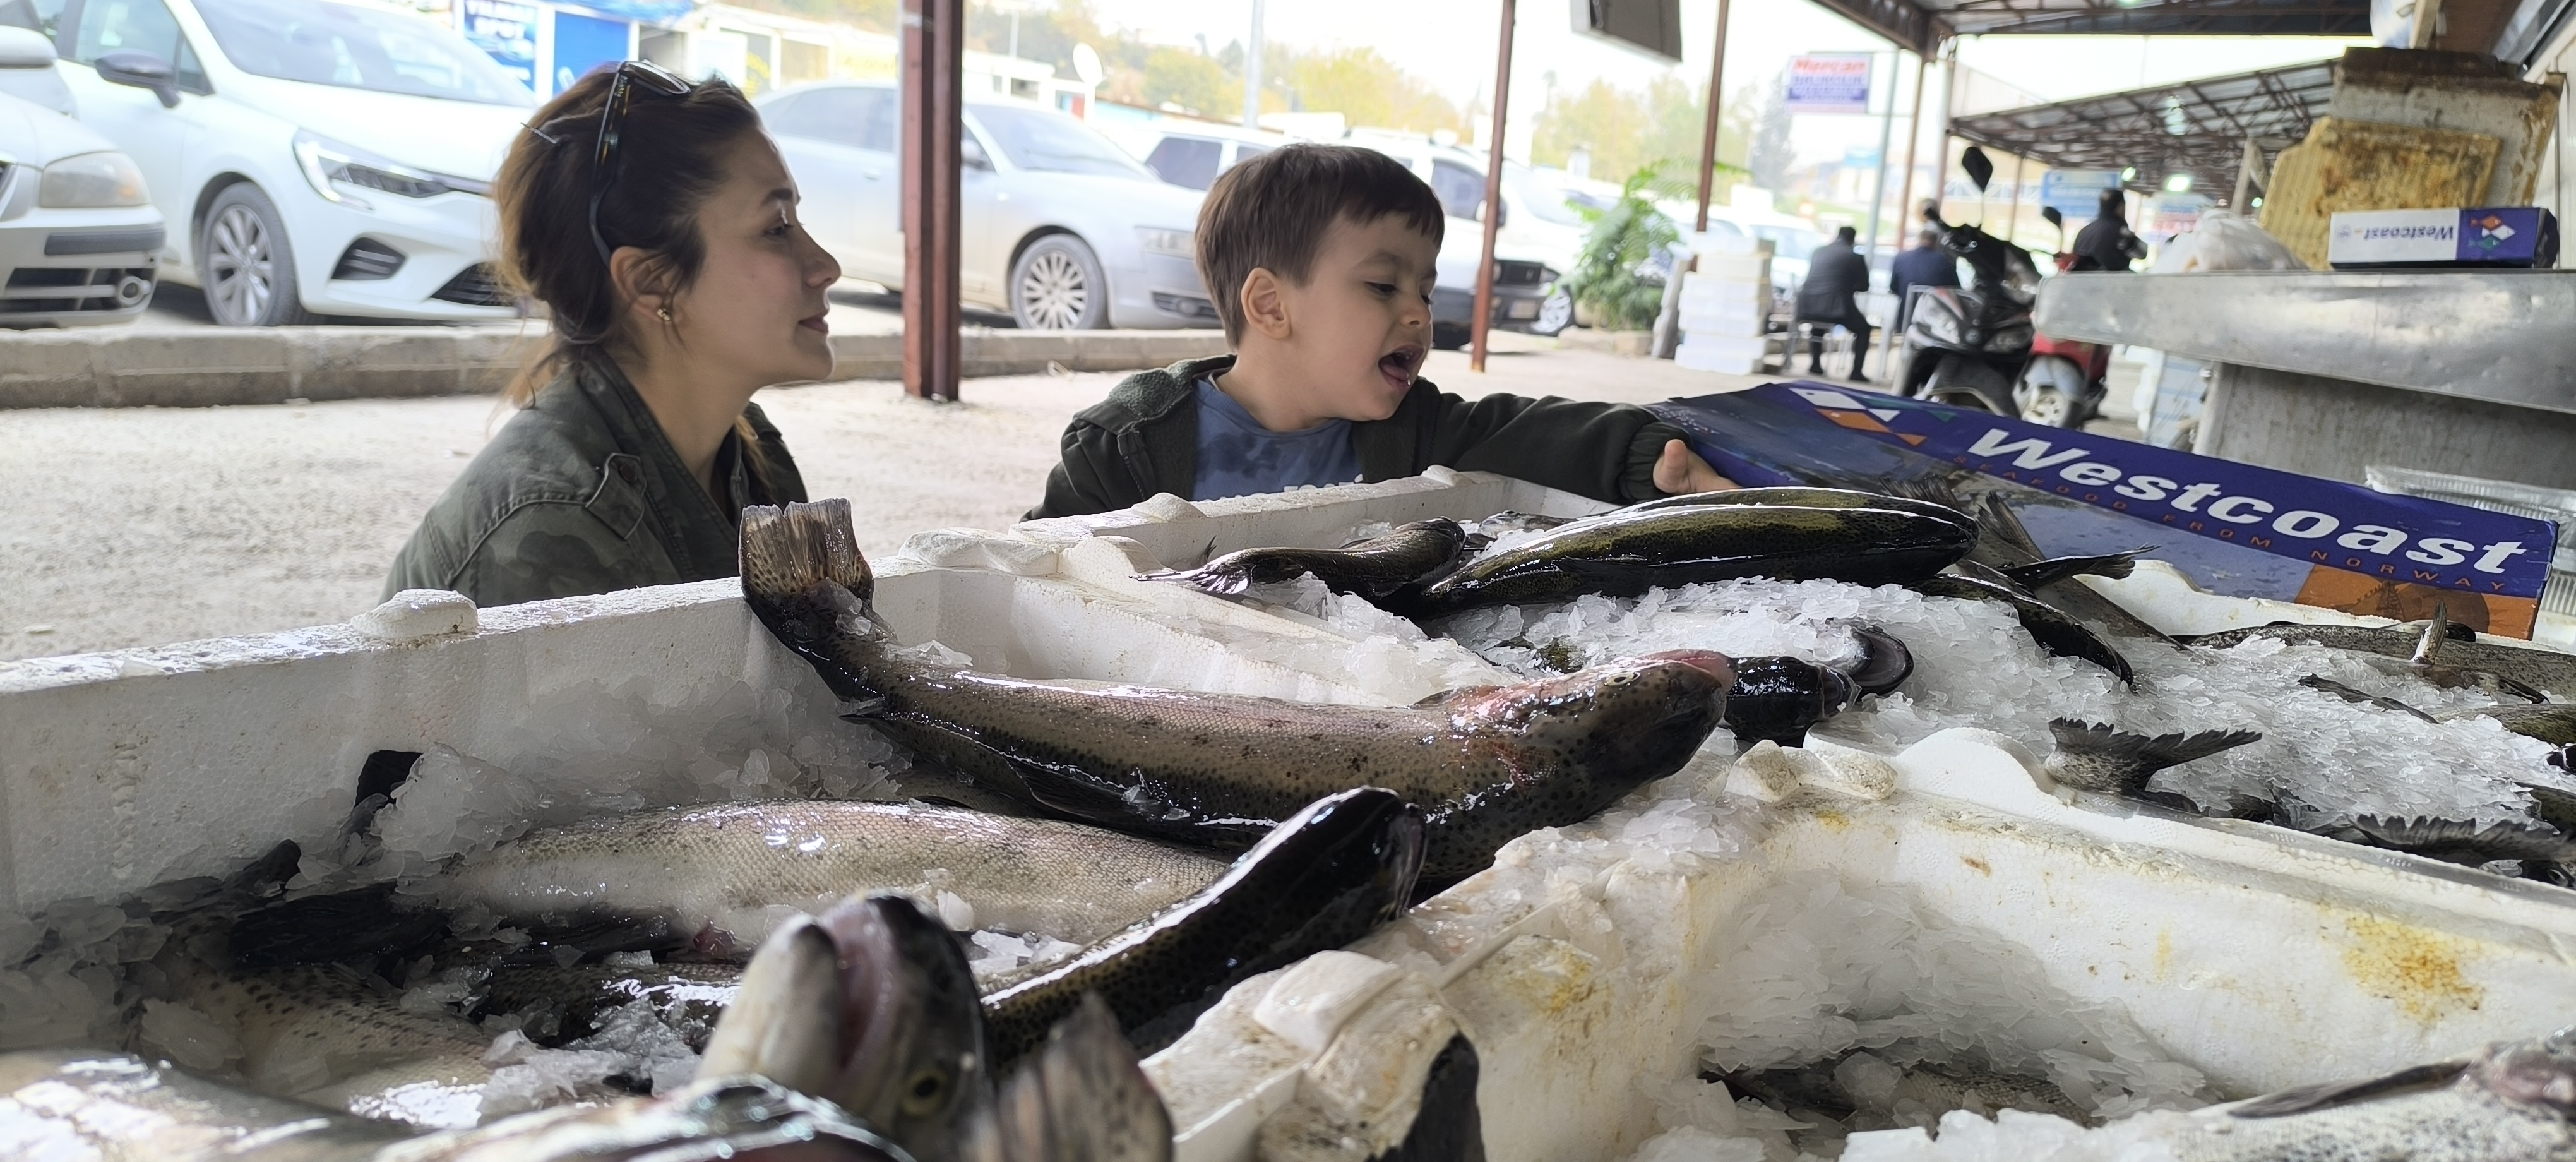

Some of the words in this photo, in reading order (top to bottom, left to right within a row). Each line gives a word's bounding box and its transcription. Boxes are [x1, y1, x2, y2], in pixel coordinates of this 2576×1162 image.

[1953, 455, 2128, 510] SEAFOOD
[2162, 513, 2272, 548] FROM
[2311, 549, 2506, 590] NORWAY
[1967, 428, 2527, 574] Westcoast
